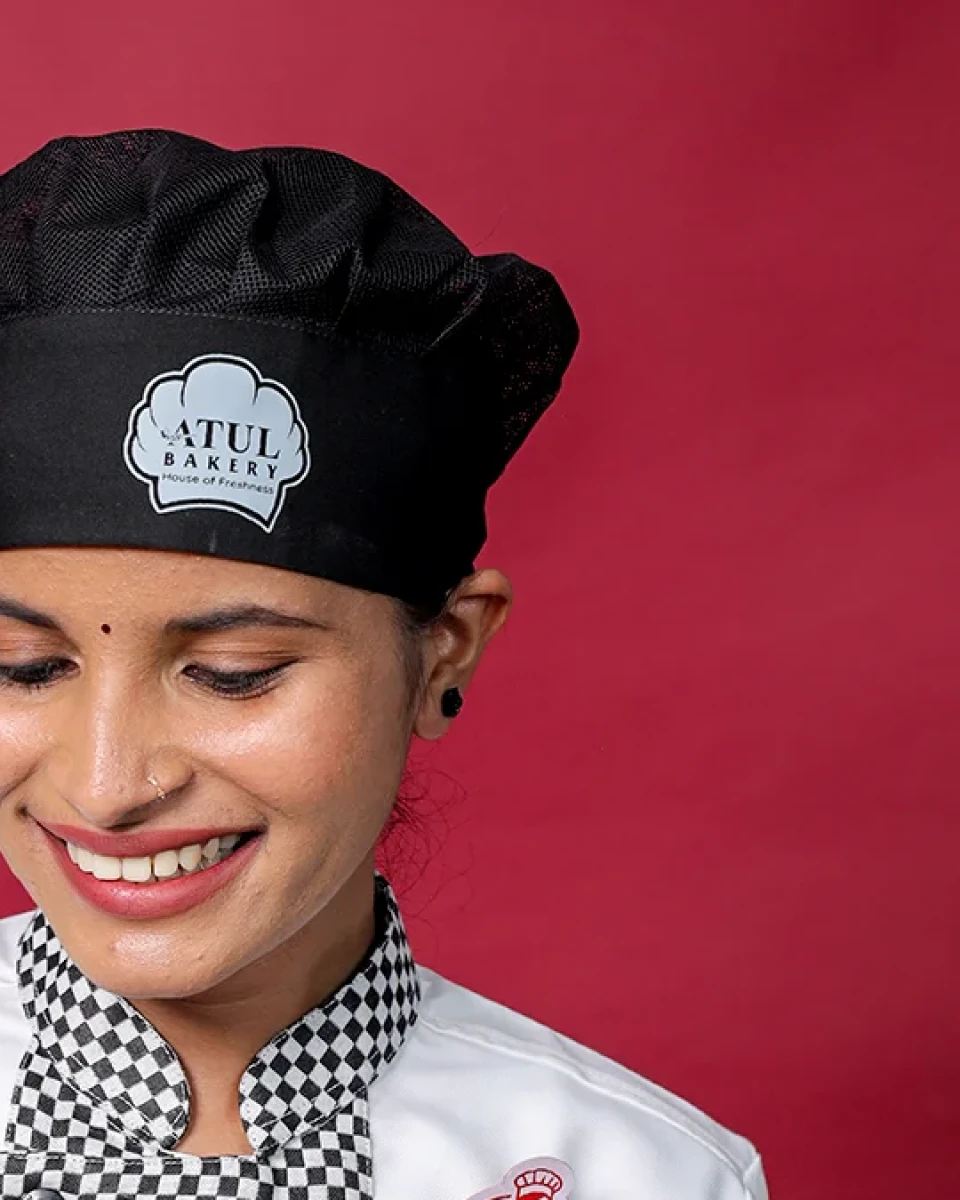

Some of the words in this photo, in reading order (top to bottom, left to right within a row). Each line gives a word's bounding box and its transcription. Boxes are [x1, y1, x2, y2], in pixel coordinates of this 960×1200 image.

[160, 419, 281, 460] ATUL
[164, 452, 278, 479] BAKERY
[162, 473, 200, 485] House
[202, 476, 216, 486] of
[218, 477, 275, 495] Freshness
